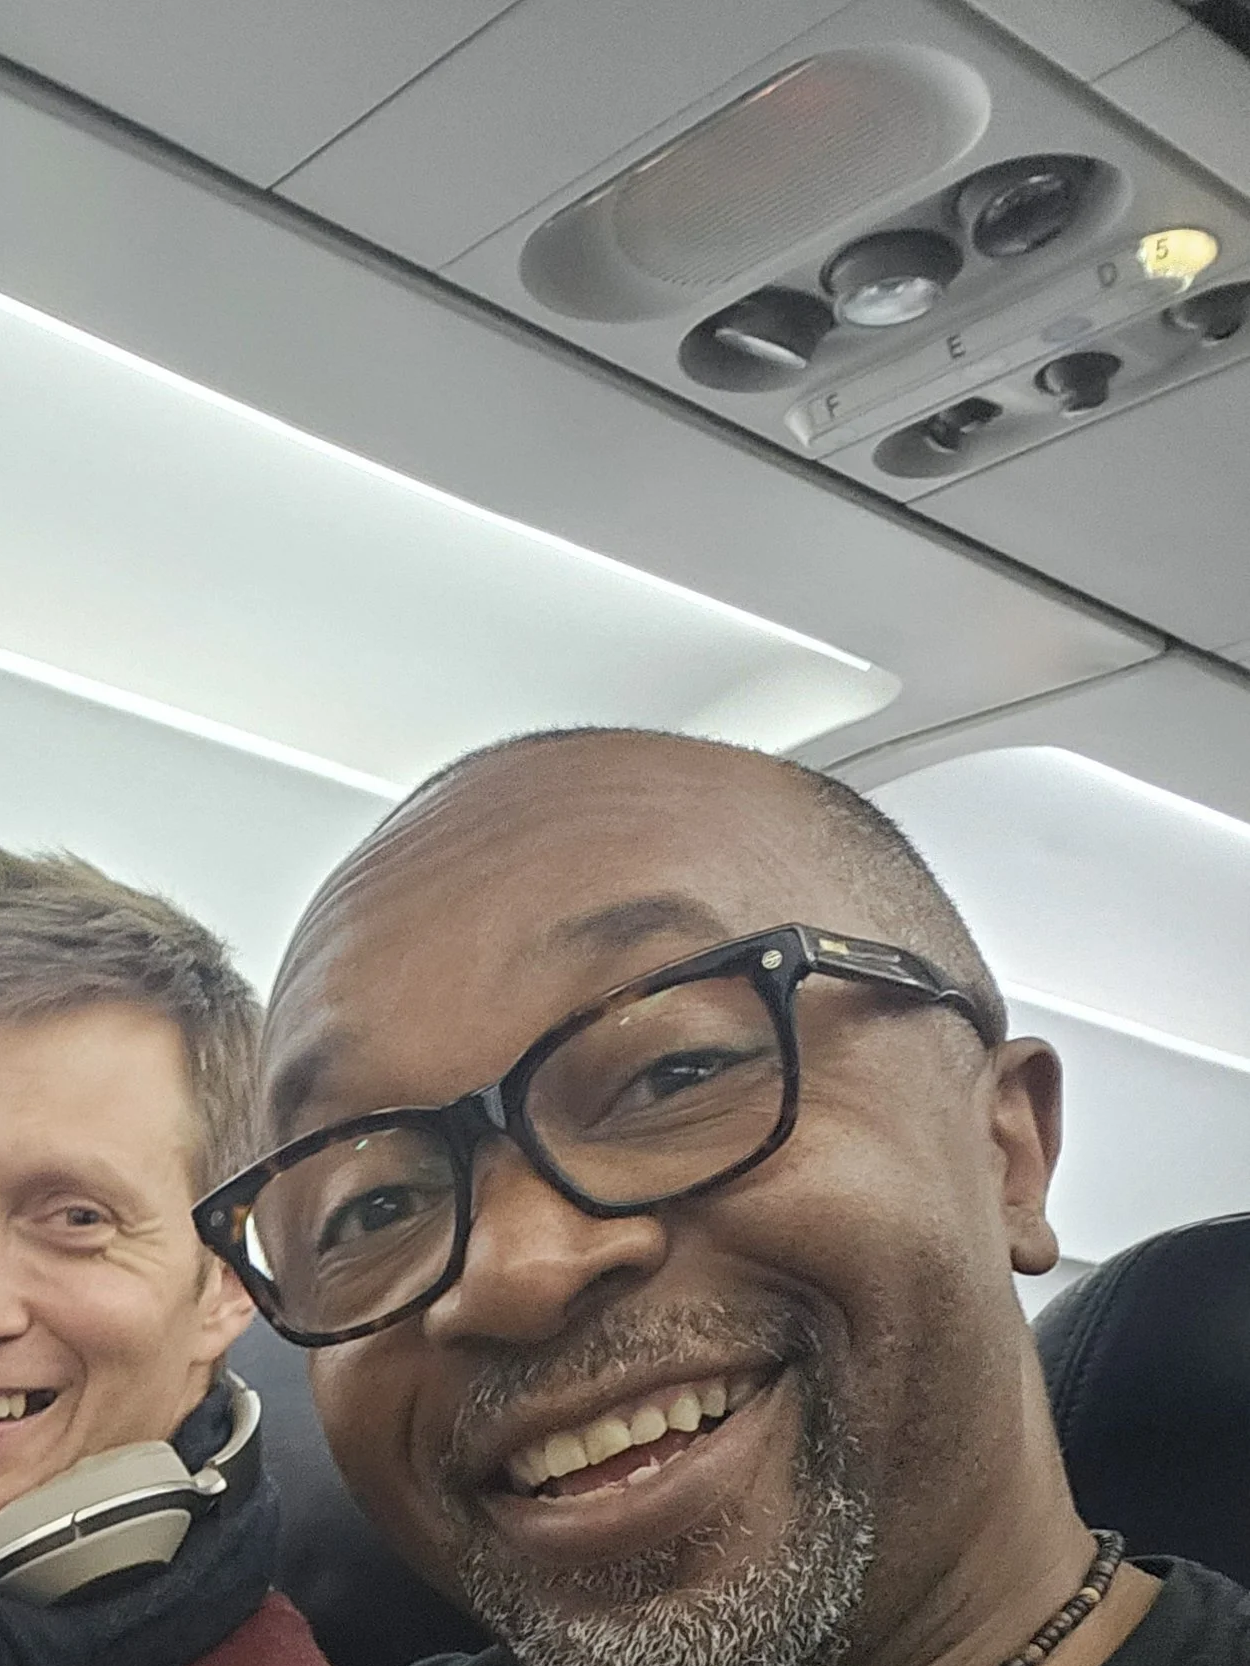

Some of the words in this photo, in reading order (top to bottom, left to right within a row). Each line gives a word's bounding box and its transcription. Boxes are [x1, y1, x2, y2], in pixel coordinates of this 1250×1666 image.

[1155, 238, 1169, 260] 5
[946, 334, 966, 359] E
[826, 392, 839, 418] F
